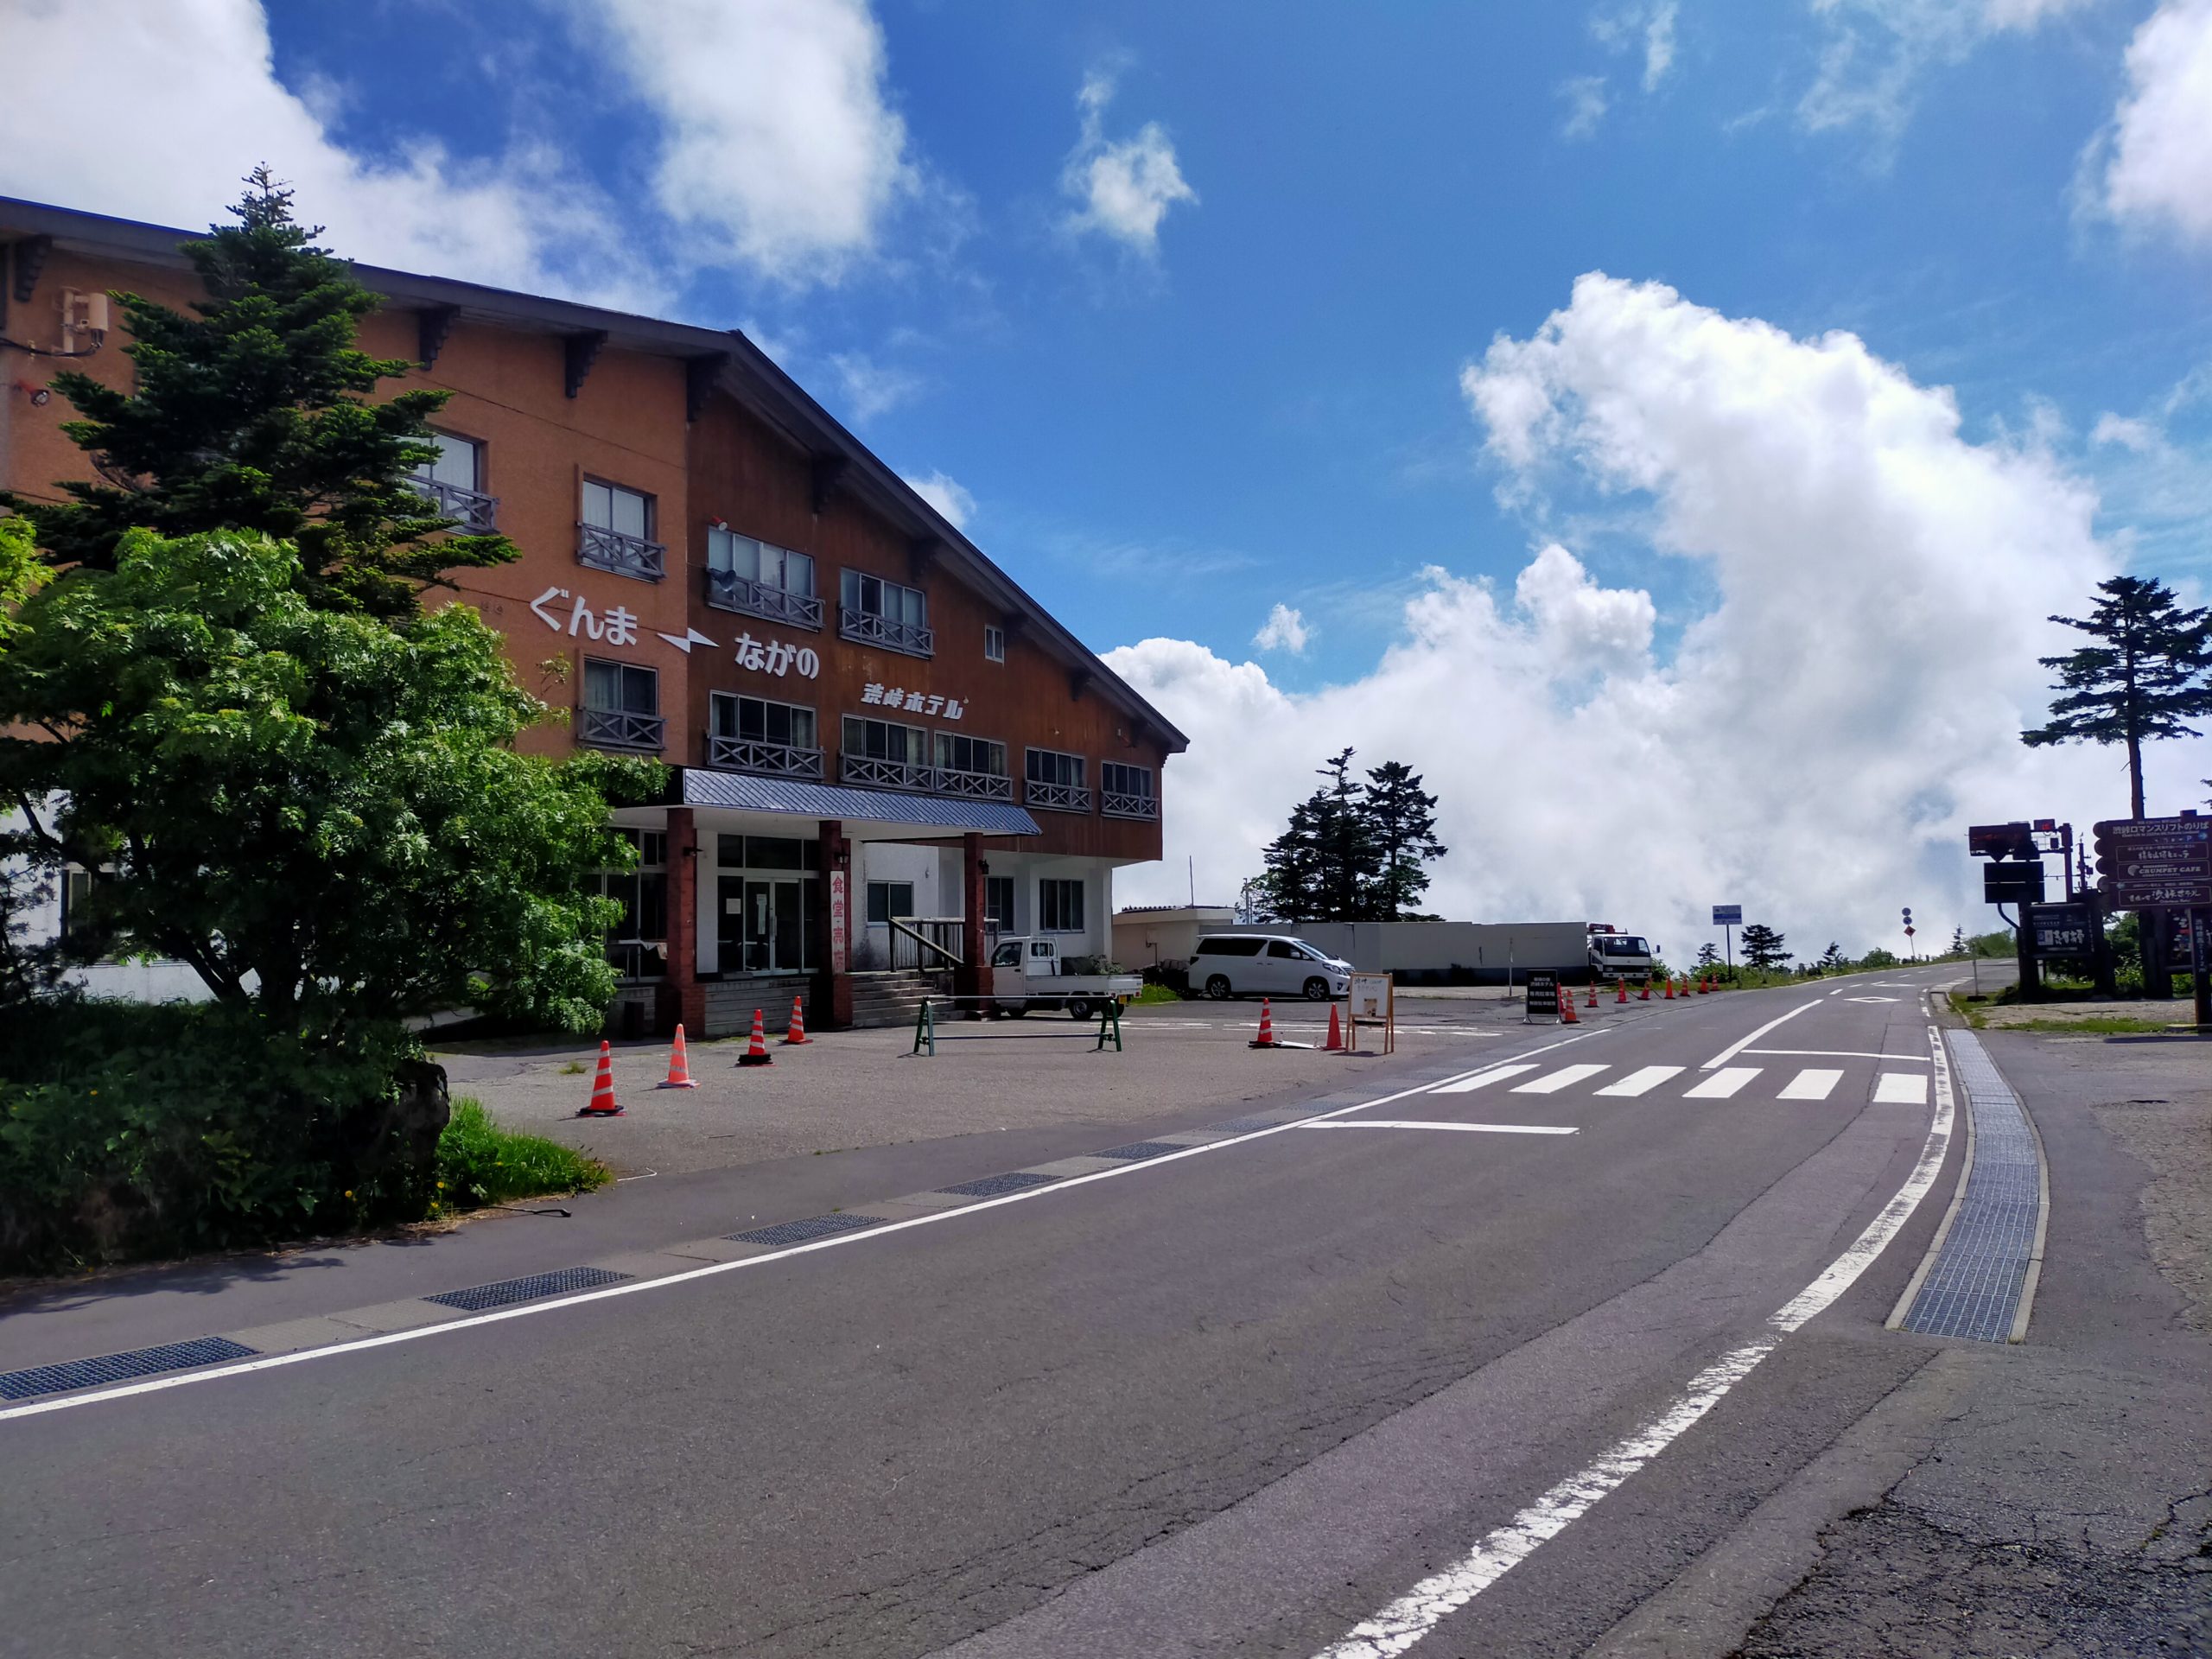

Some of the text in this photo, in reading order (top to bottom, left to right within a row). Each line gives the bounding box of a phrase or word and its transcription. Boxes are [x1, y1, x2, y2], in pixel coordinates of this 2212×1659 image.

[530, 586, 820, 680] ぐんま ながの
[861, 683, 963, 720] 渋峠ホテル
